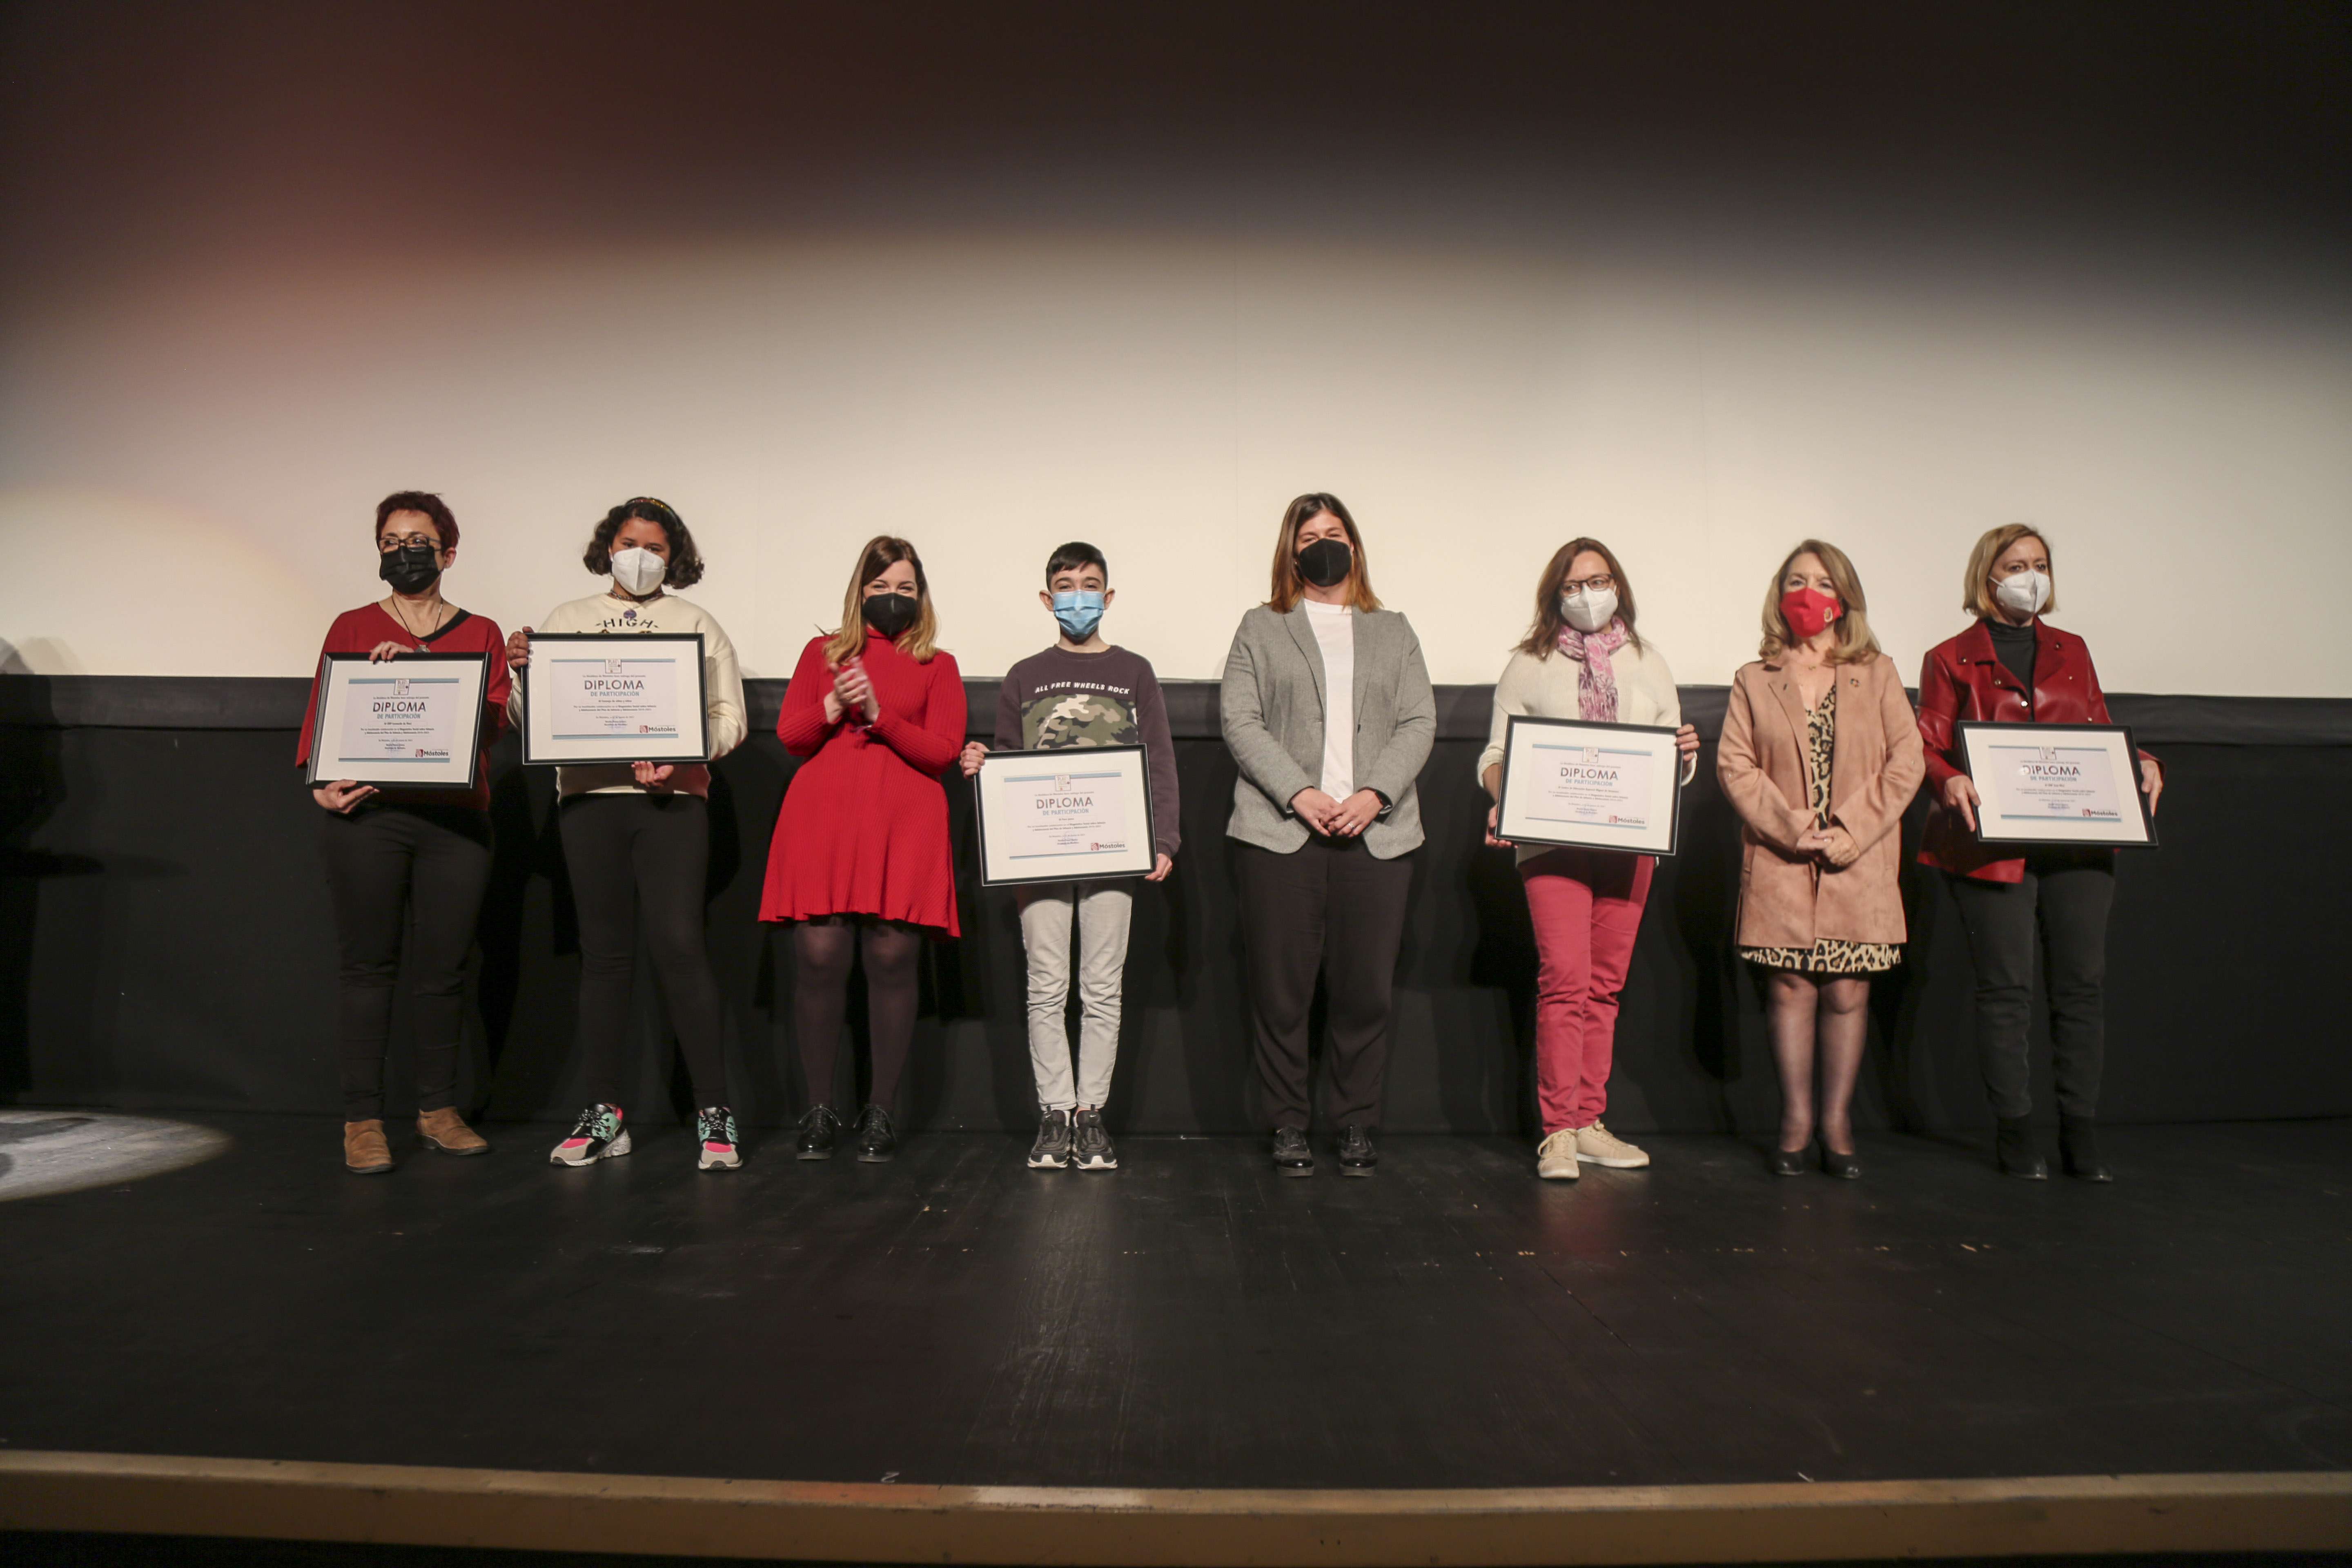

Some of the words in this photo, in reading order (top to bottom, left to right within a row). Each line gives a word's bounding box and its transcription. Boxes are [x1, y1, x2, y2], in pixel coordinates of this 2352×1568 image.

[584, 679, 644, 690] DIPLOMA
[1035, 685, 1048, 693] ALL
[1074, 682, 1105, 690] WHEELS
[1107, 685, 1130, 695] ROCK
[373, 702, 426, 712] DIPLOMA
[1560, 767, 1618, 780] DIPLOMA
[2021, 765, 2081, 775] DIPLOMA
[1036, 797, 1094, 809] DIPLOMA
